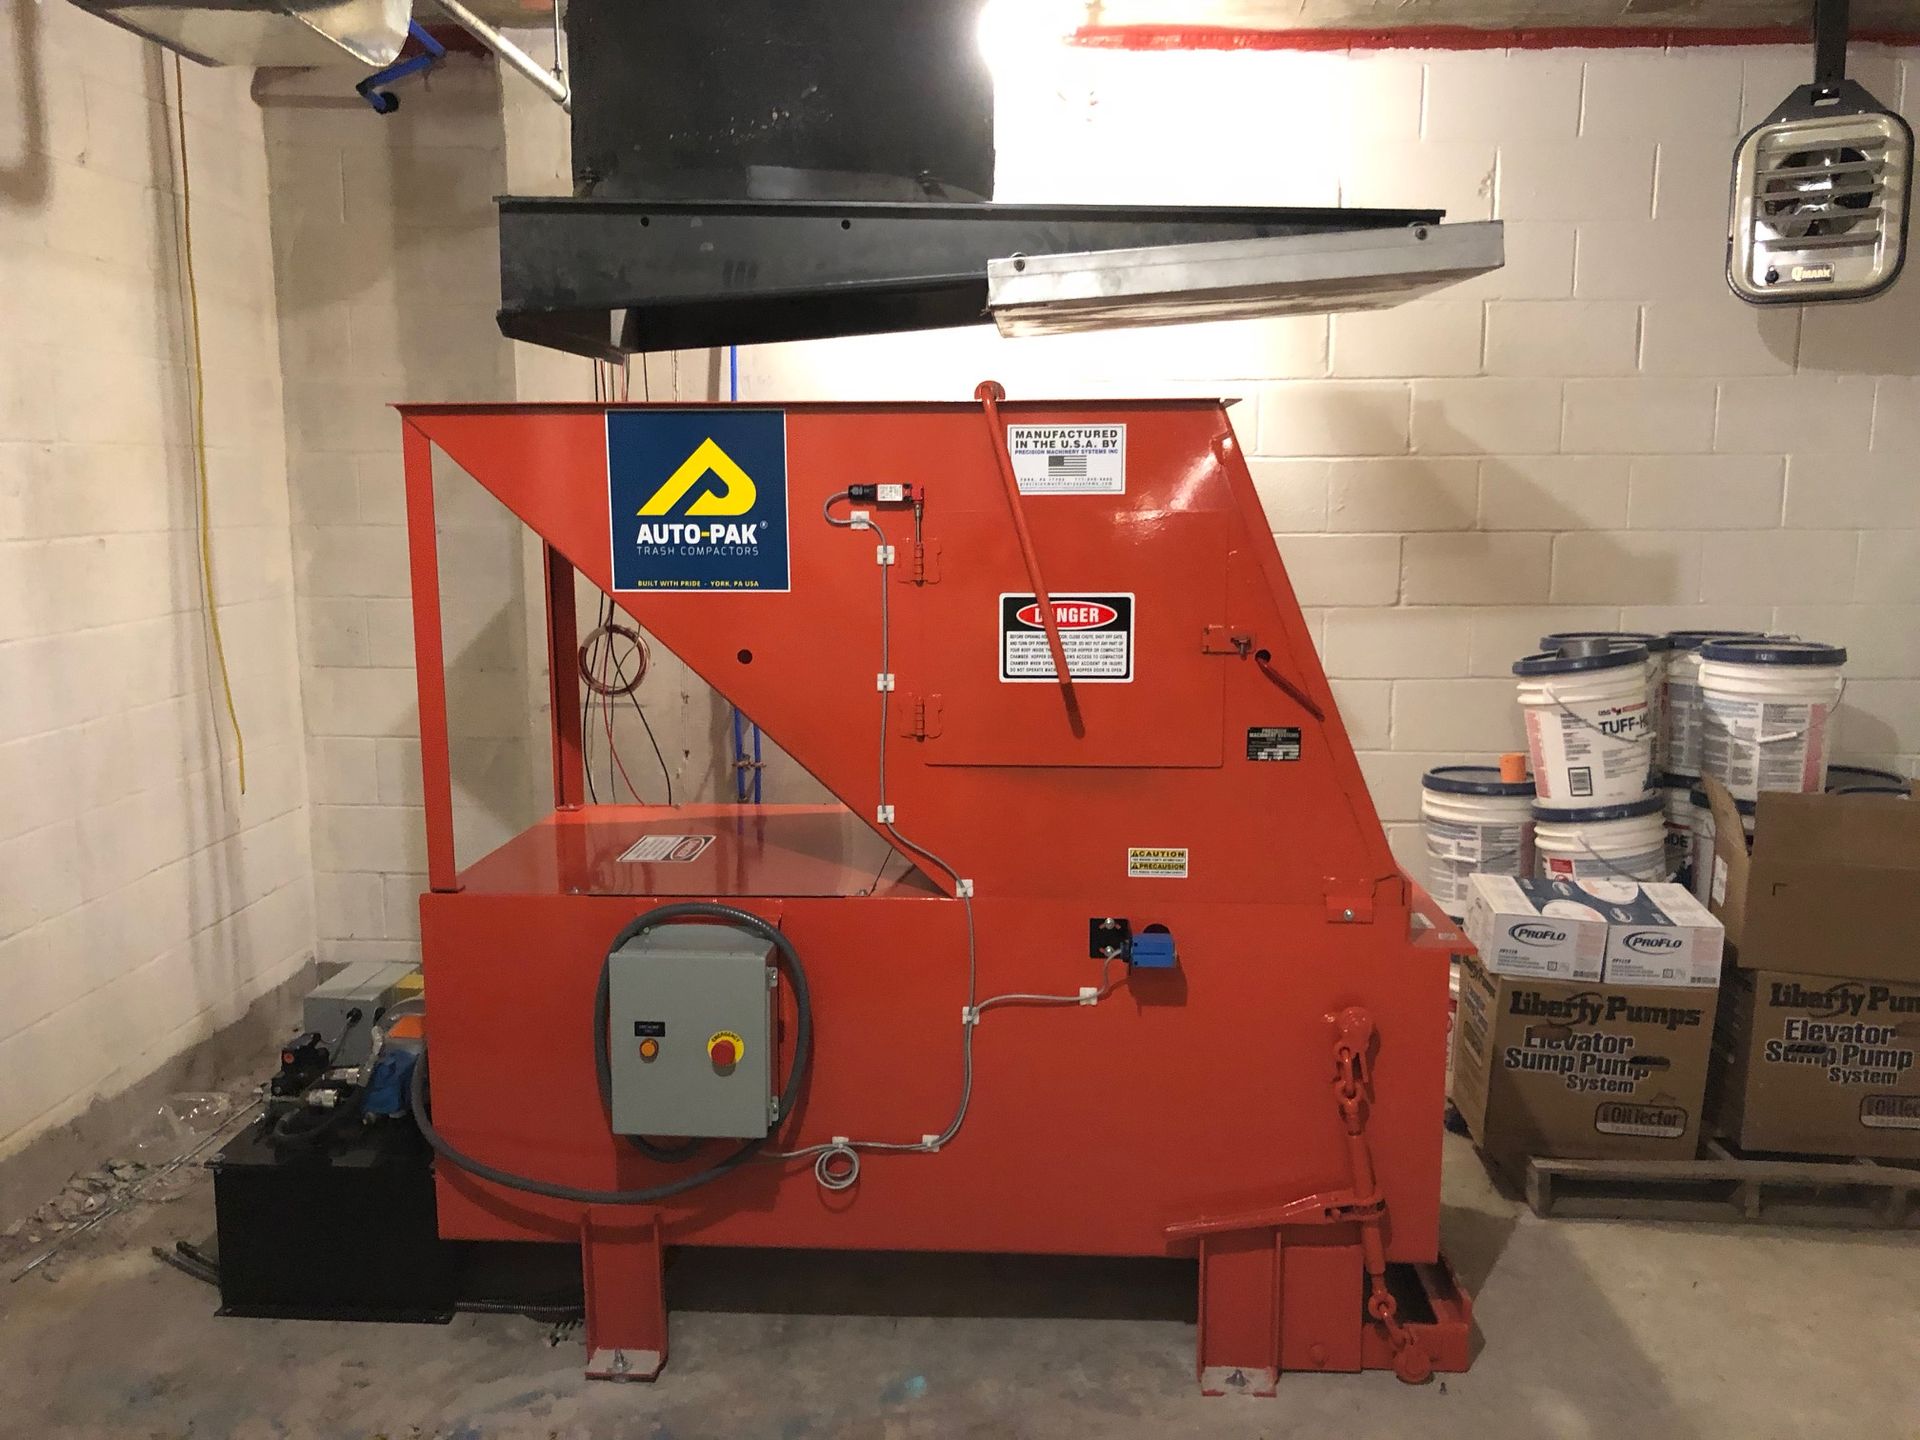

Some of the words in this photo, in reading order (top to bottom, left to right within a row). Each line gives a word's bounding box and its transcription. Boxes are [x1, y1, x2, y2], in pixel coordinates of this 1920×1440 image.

[1015, 429, 1118, 439] MANUFACTURED
[1015, 440, 1028, 448] IN
[1033, 440, 1056, 448] THE
[1061, 440, 1097, 448] U.S.A.
[1102, 439, 1118, 448] BY
[636, 523, 758, 545] AUTO-PAK
[637, 546, 675, 556] TRASH
[680, 546, 759, 556] COMPACTORS
[1034, 608, 1099, 623] DNGER
[1769, 982, 1866, 1016] Liberty
[1509, 990, 1604, 1025] Liberty
[1604, 996, 1704, 1031] Pumps
[1785, 1019, 1897, 1045] Elevator
[1504, 1047, 1575, 1075] Sump
[1842, 1044, 1913, 1071] Pump
[1566, 1074, 1634, 1094] System
[1829, 1067, 1897, 1084] System
